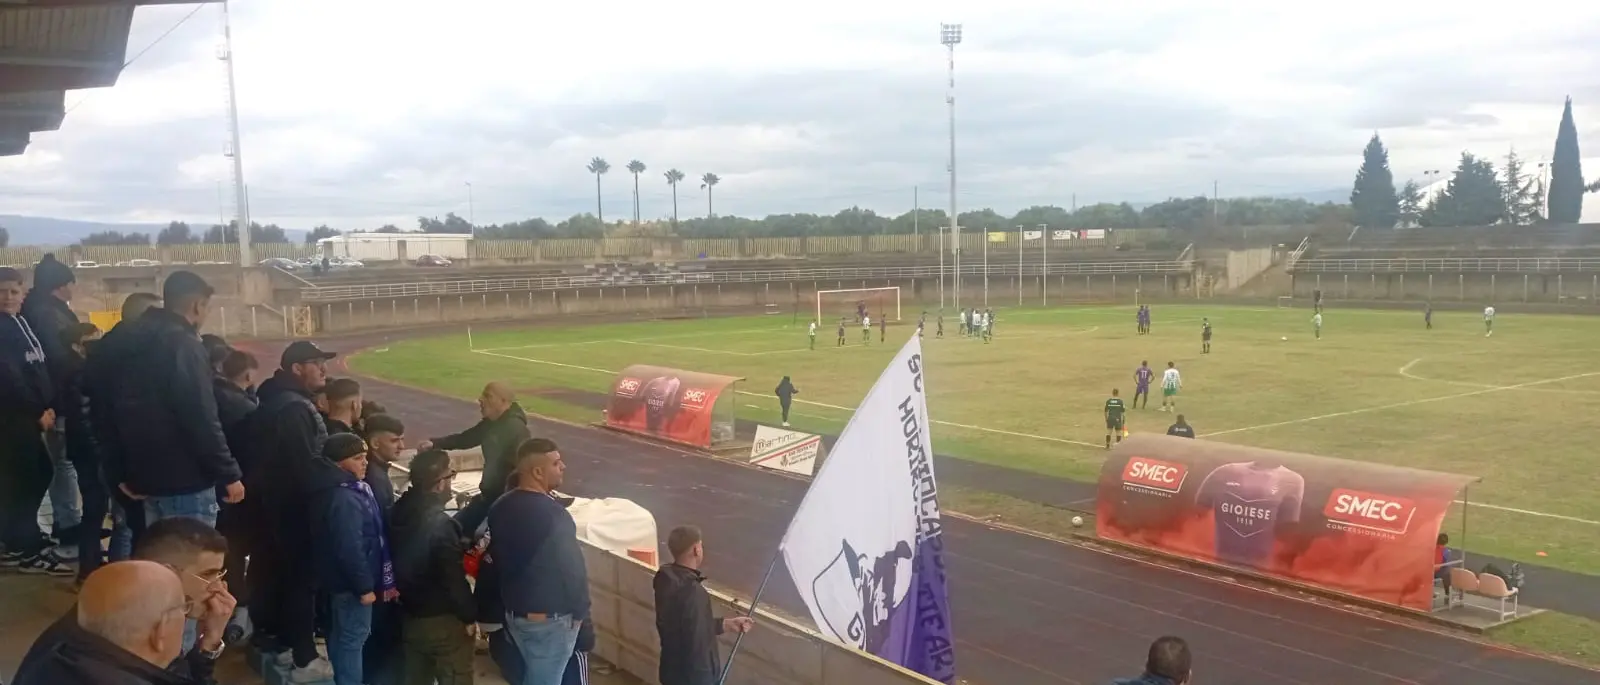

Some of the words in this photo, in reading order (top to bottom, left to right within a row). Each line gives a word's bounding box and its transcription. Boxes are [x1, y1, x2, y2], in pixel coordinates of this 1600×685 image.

[1129, 461, 1178, 483] SMEC
[1221, 502, 1271, 520] GIOIESE
[1334, 494, 1402, 521] SMEC
[1326, 523, 1396, 540] CONCESSIONARIA
